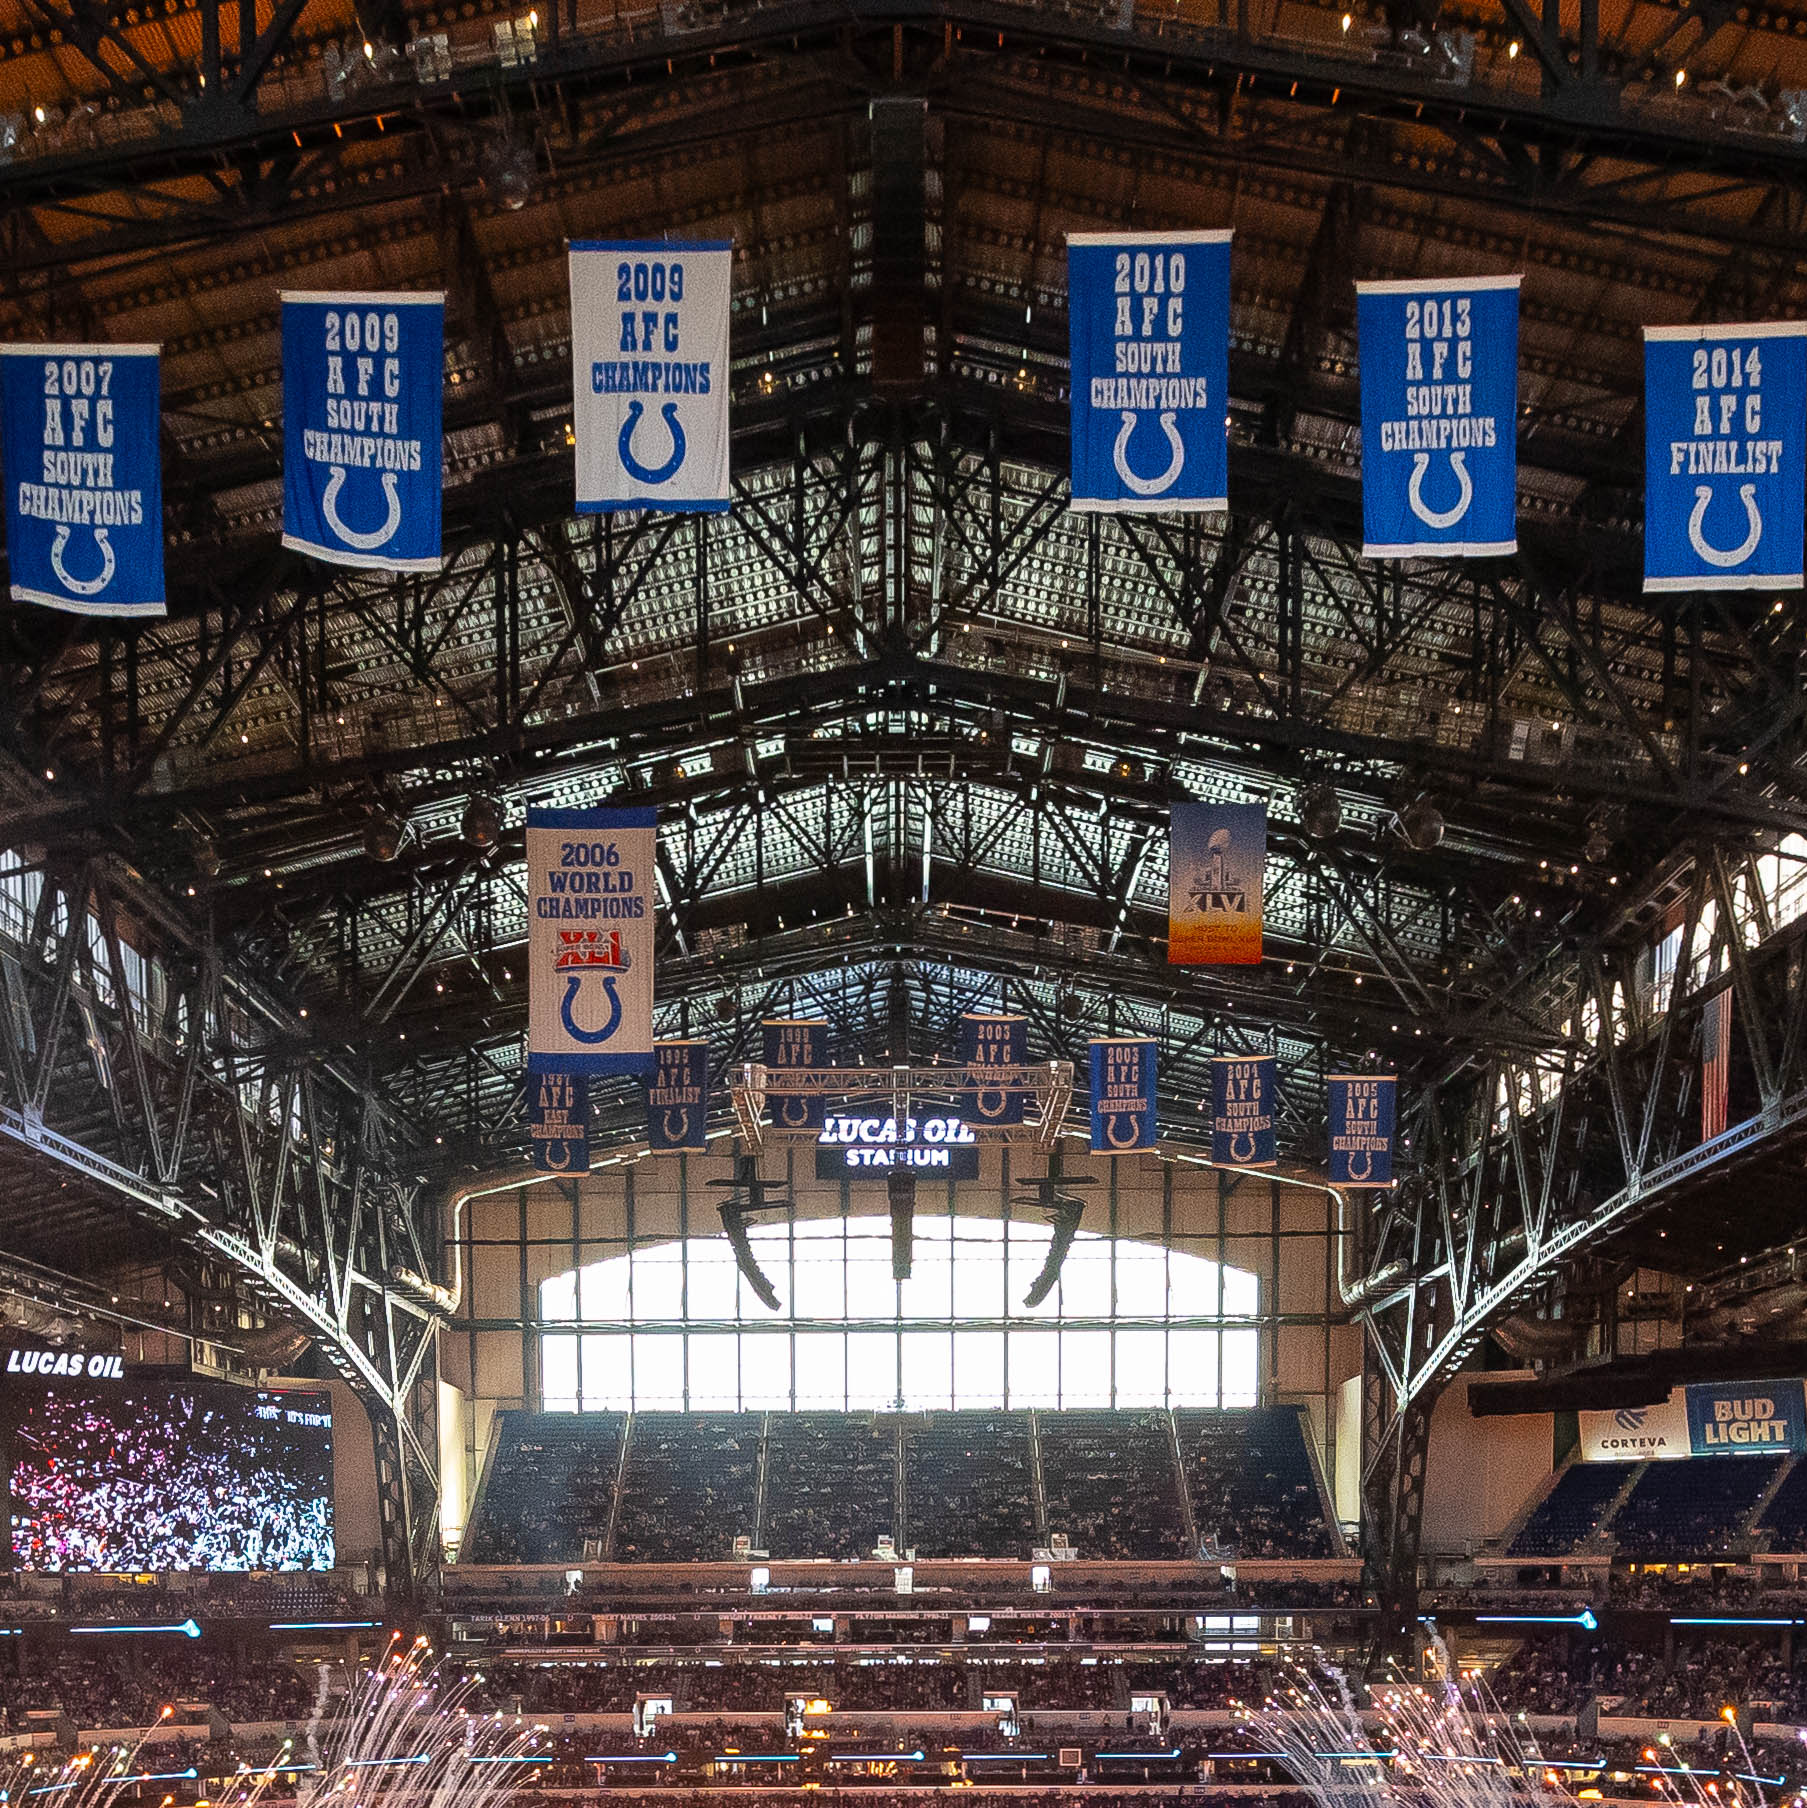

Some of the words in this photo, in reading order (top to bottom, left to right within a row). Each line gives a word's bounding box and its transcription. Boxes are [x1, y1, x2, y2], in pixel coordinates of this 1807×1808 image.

[618, 263, 684, 302] 2009
[1115, 253, 1185, 293] 2010
[1405, 299, 1471, 339] 2013
[326, 313, 400, 351] 2009
[1115, 342, 1181, 374] SOUTH
[1692, 347, 1762, 388] 2014
[44, 362, 112, 396] 2007
[592, 360, 711, 394] CHAMPIONS
[1090, 377, 1206, 409] CHAMPIONS
[1406, 385, 1472, 415] SOUTH
[326, 399, 398, 434] SOUTH
[1381, 418, 1496, 450] CHAMPIONS
[303, 433, 421, 471] CHAMPIONS
[1670, 440, 1782, 474] FINALIST
[43, 452, 113, 487] SOUTH
[18, 486, 141, 524] CHAMPIONS
[561, 842, 620, 867] 2006
[548, 871, 633, 893] WORLD
[537, 896, 644, 919] CHAMPIONS
[978, 1024, 1010, 1041] 2003
[1107, 1047, 1138, 1064] 2003
[1227, 1064, 1259, 1079] 2004
[649, 1088, 701, 1105] FINALIST
[1107, 1084, 1138, 1097] SOUTH
[1347, 1083, 1377, 1097] 2005
[1098, 1098, 1147, 1114] CHAMPIONS
[1227, 1103, 1259, 1116] SOUTH
[531, 1124, 584, 1139] CHAMPIONS
[923, 1119, 975, 1143] OIL
[1216, 1116, 1271, 1132] CHAMPIONS
[1346, 1121, 1377, 1134] SOUTH
[1333, 1137, 1388, 1151] CHAMPIONS
[847, 1149, 950, 1166] STAIUM
[7, 1350, 85, 1377] LUCAS
[88, 1354, 124, 1379] OIL
[1714, 1399, 1775, 1422] BUD
[1601, 1436, 1666, 1449] CORTEVA
[1705, 1419, 1788, 1444] LIGHT
